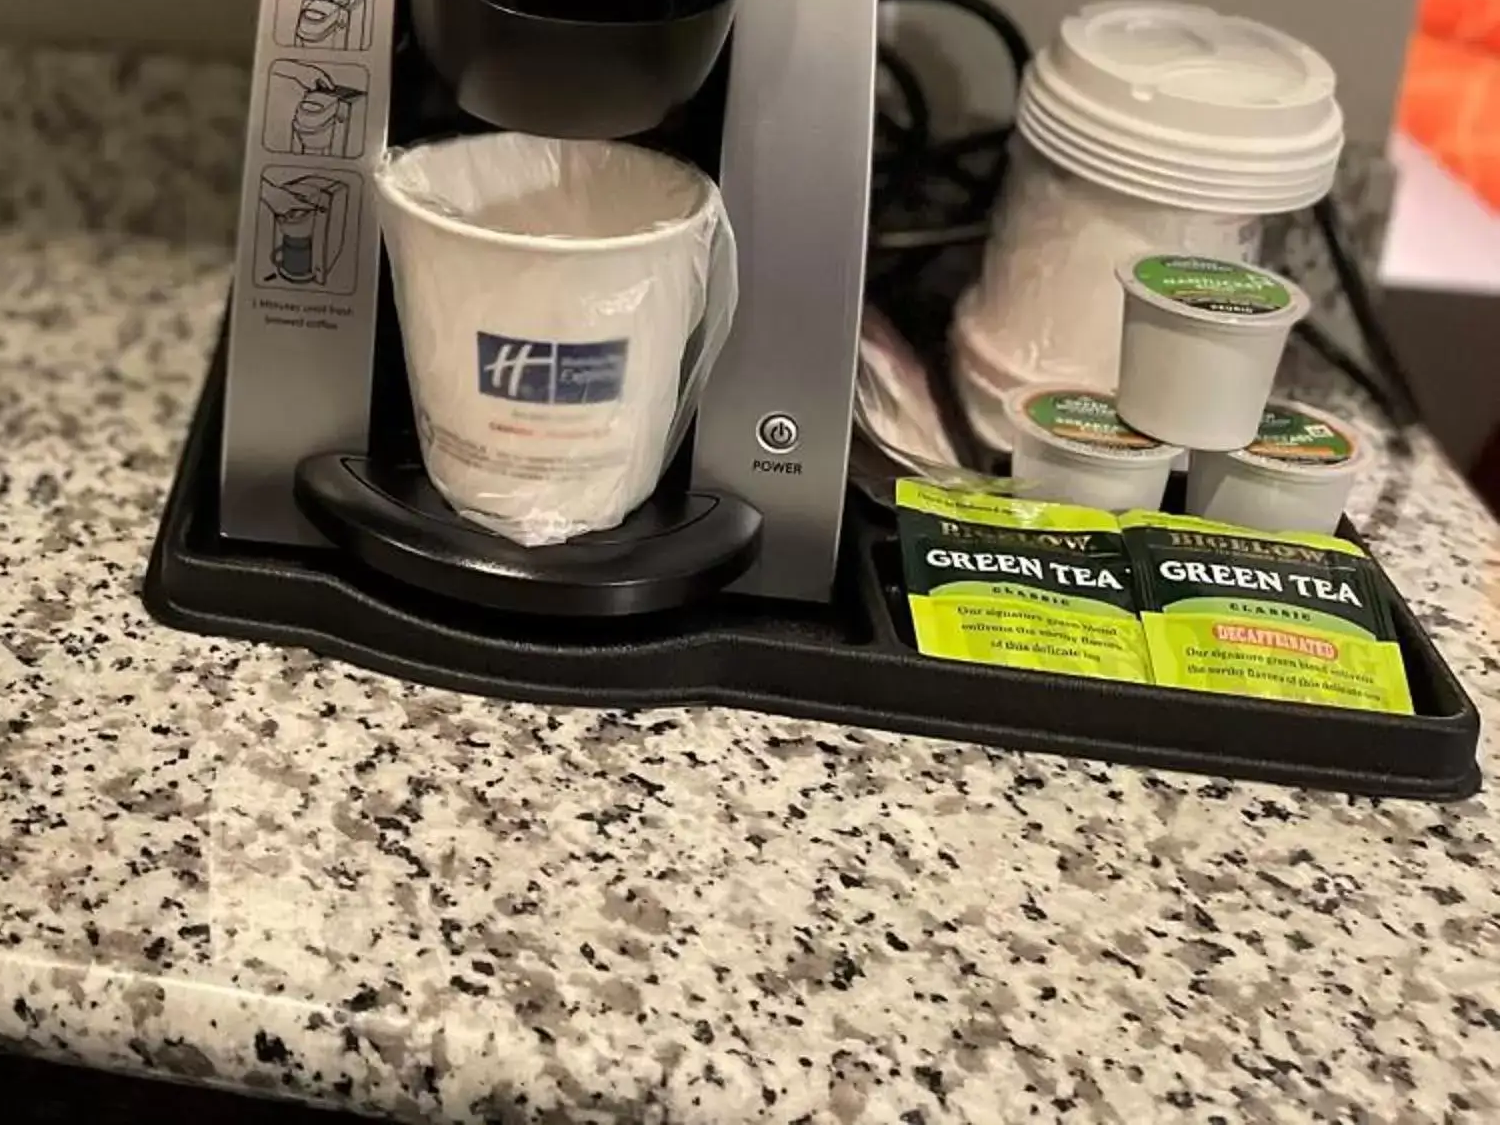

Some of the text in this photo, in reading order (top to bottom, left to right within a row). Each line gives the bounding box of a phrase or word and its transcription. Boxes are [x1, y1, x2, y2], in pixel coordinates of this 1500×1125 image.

[753, 459, 803, 475] POWER
[926, 548, 1124, 590] GREEN TEA
[1159, 560, 1363, 608] GREEN TEA
[1228, 601, 1313, 623] CLASSIC
[1216, 623, 1336, 659] DECAFFEINATED
